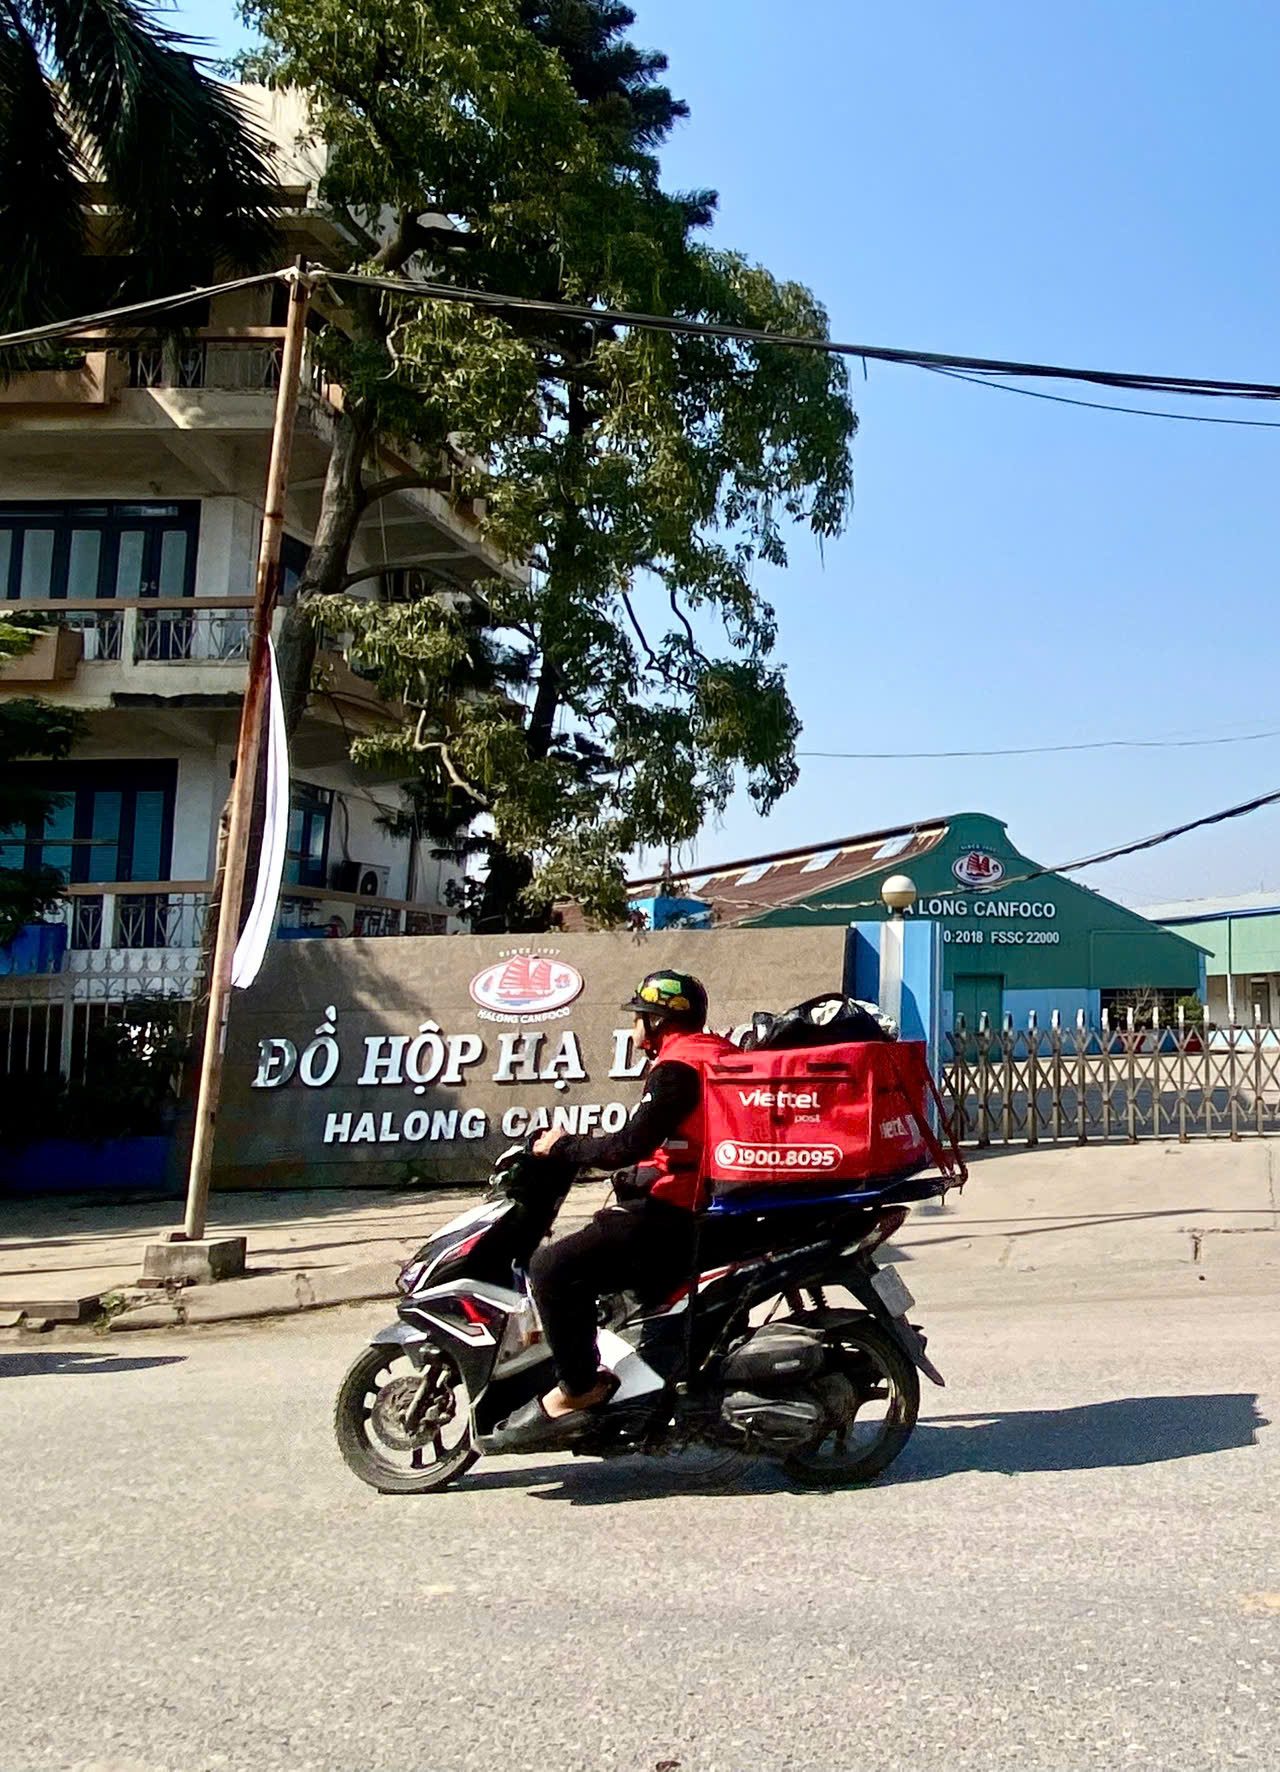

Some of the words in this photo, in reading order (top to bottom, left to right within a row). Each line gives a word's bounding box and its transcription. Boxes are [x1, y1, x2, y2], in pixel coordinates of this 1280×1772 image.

[918, 899, 968, 916] LONG
[974, 901, 1057, 918] CANFOCO
[991, 931, 1024, 944] FSSC
[1025, 931, 1061, 944] 22000
[477, 1009, 520, 1024] HALONG
[520, 1007, 570, 1024] CANFOCO
[251, 1005, 340, 1088] ĐỒ
[357, 1019, 484, 1095] HỘP
[492, 1030, 586, 1090] HẠ
[738, 1089, 820, 1109] viettel
[323, 1107, 487, 1144] HALONG
[794, 1114, 821, 1123] post
[737, 1149, 835, 1166] 1900.8095
